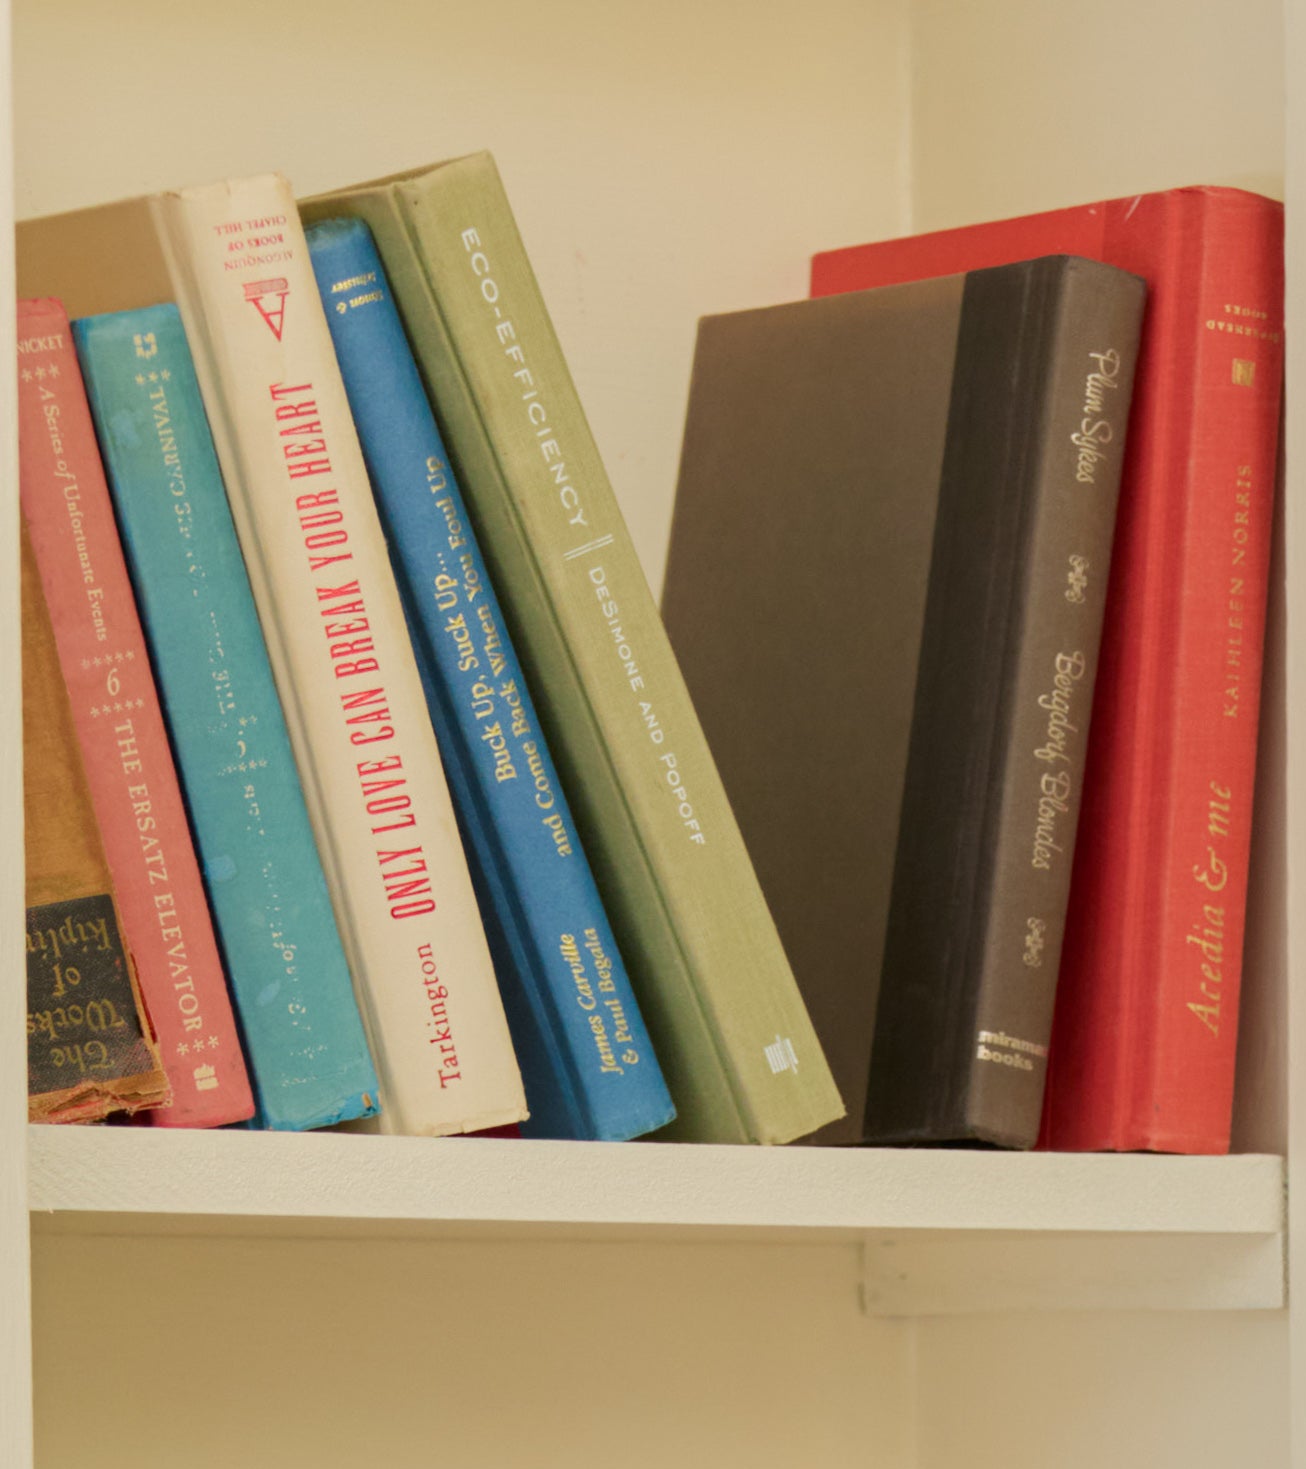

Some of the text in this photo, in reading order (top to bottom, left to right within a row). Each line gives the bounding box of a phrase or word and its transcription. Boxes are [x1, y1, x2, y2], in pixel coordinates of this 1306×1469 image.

[213, 214, 288, 237] CHAPEL HILL
[223, 250, 294, 271] ALGONQUIN
[227, 233, 285, 252] BOOKS OF
[461, 227, 588, 528] ECO-EFFICIENCY
[1070, 347, 1121, 485] Plum Sykes
[39, 385, 108, 643] A Series of Unfortunate Events
[269, 382, 437, 921] ONLY LOVE CAN BREAK YOUR HEART
[426, 455, 574, 859] and Come Back When You Foul Up
[1221, 463, 1254, 720] KATHLEEN NORRIS
[106, 667, 121, 696] 6
[444, 612, 518, 785] Buck Up, Suck
[639, 700, 664, 746] AND
[660, 752, 706, 846] POPOFF
[1031, 650, 1085, 872] Bergdorf Blondes
[114, 718, 204, 1033] THE ERSATZ ELEVATOR
[1185, 780, 1234, 1038] Acedia & me
[26, 998, 126, 1040] Works
[52, 963, 82, 998] of
[416, 942, 463, 1090] Tarkington
[559, 933, 625, 1076] James Carville
[584, 927, 617, 994] Begala
[604, 998, 634, 1044] Paul
[51, 1039, 116, 1074] The
[976, 1044, 1034, 1071] books
